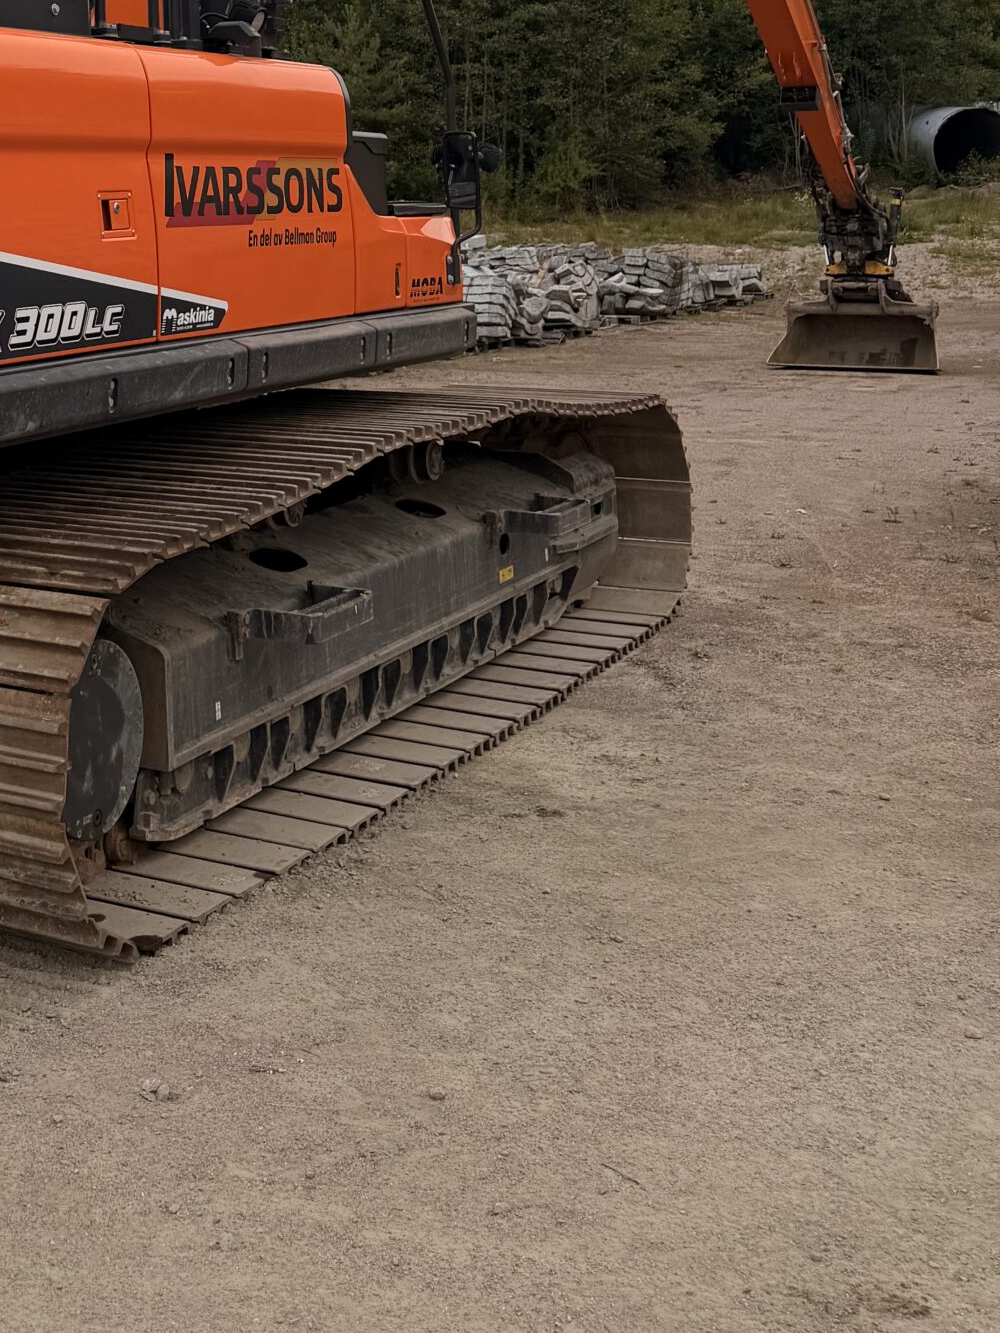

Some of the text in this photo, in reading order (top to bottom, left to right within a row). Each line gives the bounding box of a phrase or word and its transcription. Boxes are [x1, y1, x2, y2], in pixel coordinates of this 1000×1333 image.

[164, 153, 343, 217] IVARSSONS
[248, 227, 337, 248] En del av Bellman Group
[410, 276, 443, 298] MOBA
[161, 306, 215, 333] Maskinia
